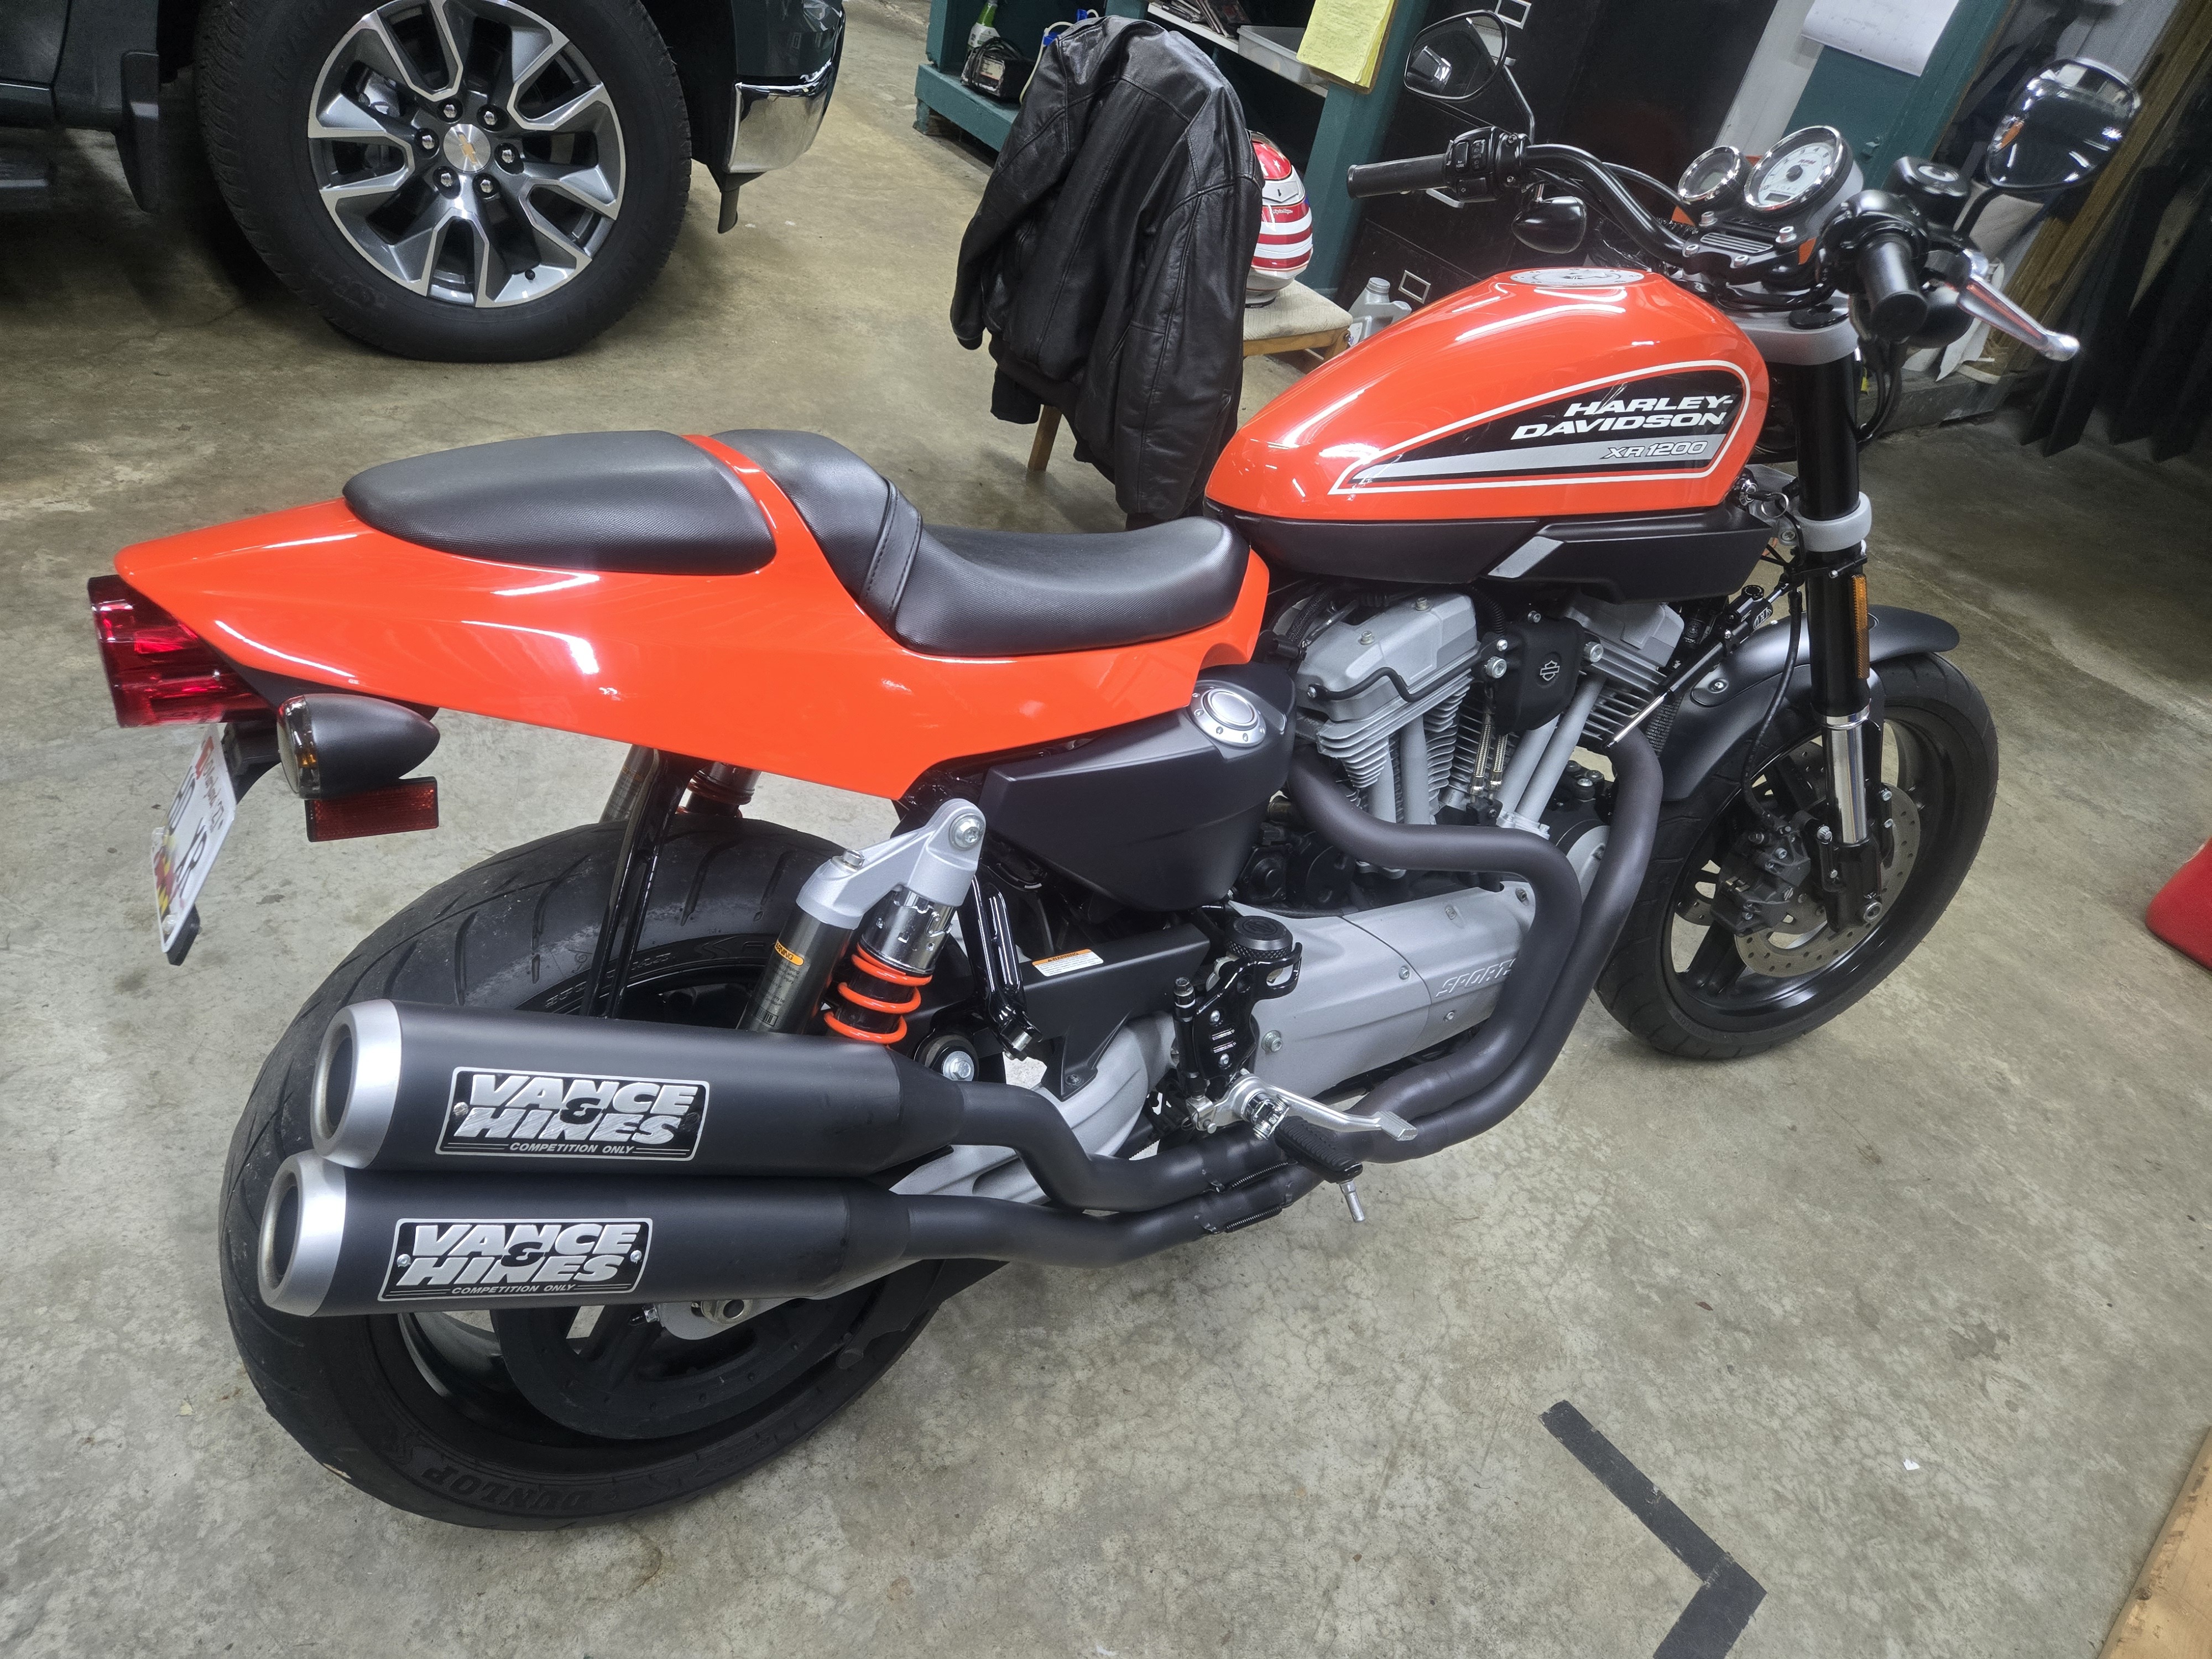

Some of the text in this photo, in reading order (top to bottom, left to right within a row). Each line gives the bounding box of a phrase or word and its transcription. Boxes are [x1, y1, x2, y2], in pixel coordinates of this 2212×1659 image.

[1564, 395, 1733, 418] HARLEY-
[1510, 412, 1726, 440] DAVIDSON
[469, 1074, 698, 1116] VANCE
[453, 1107, 682, 1145] HINES
[509, 1142, 635, 1155] COMPETITION ONLY
[412, 1223, 641, 1256] VANCE
[395, 1254, 625, 1286] HINES
[451, 1283, 576, 1295] COMPETITION ONLY
